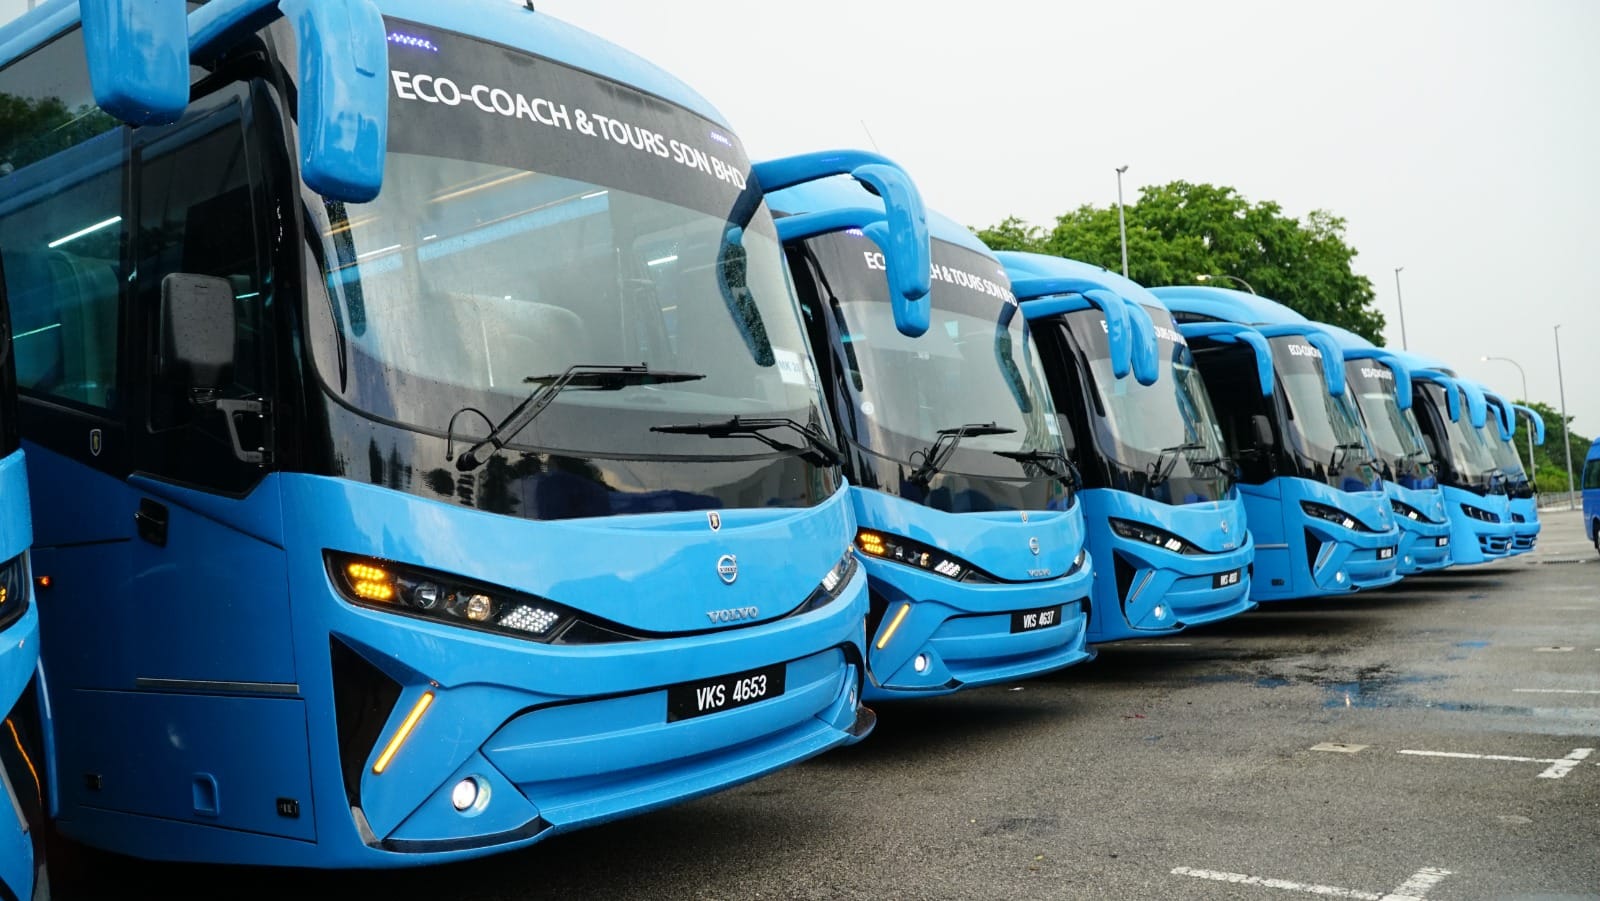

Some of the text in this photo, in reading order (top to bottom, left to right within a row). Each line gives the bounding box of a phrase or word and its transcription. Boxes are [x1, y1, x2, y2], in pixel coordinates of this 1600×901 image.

[391, 69, 747, 191] ECO-COACH & TOURS SDN BHD
[949, 267, 985, 293] TOURS
[706, 606, 758, 624] VOLVO
[696, 674, 767, 712] VKS 4653
